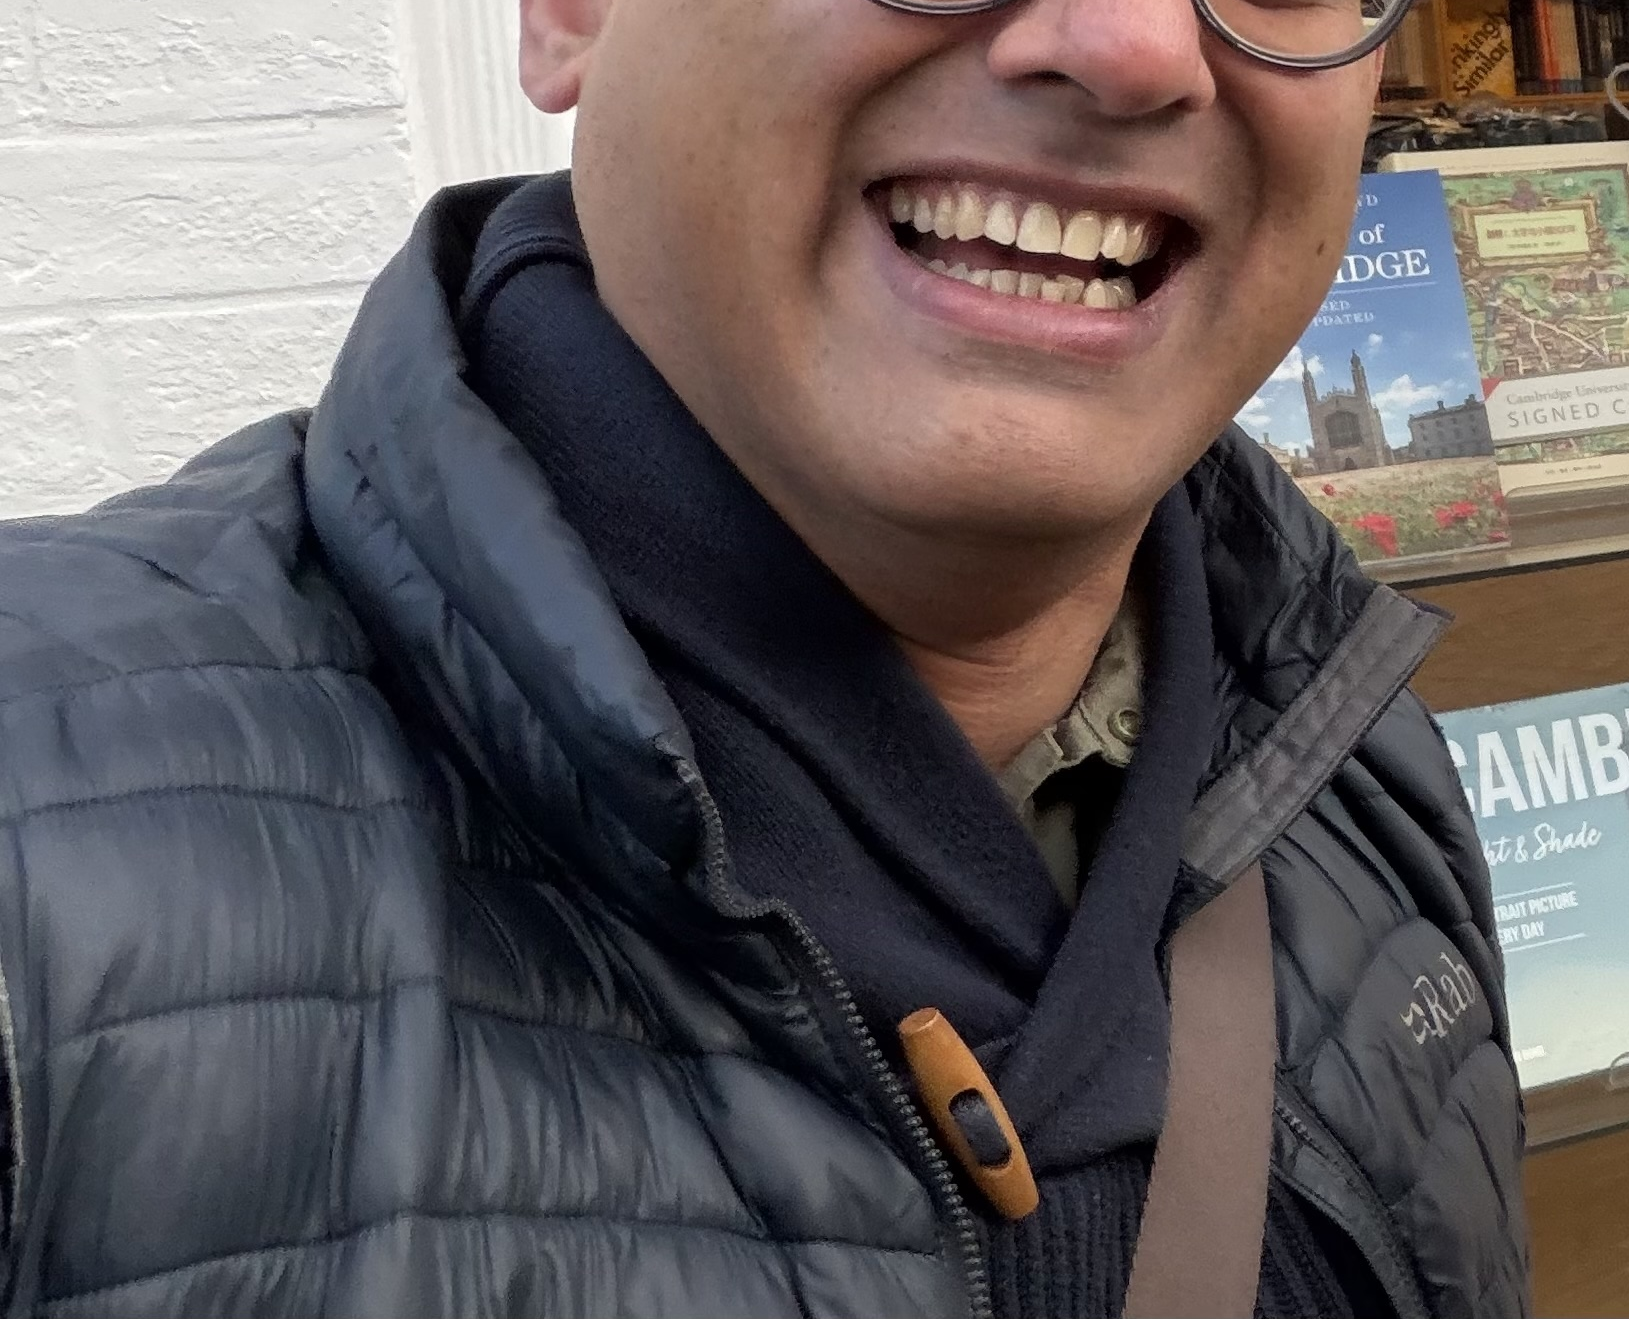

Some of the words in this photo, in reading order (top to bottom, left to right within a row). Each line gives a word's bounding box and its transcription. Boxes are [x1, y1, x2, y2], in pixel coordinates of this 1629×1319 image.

[1359, 224, 1385, 244] of
[1335, 249, 1431, 283] IDGE
[1506, 388, 1574, 407] Cambridge
[1506, 399, 1600, 429] SIGNED
[1514, 835, 1529, 863] &
[1533, 821, 1602, 861] Shade
[1494, 901, 1528, 923] TRAIT
[1528, 890, 1579, 915] PICTURE
[1520, 921, 1545, 940] DAY
